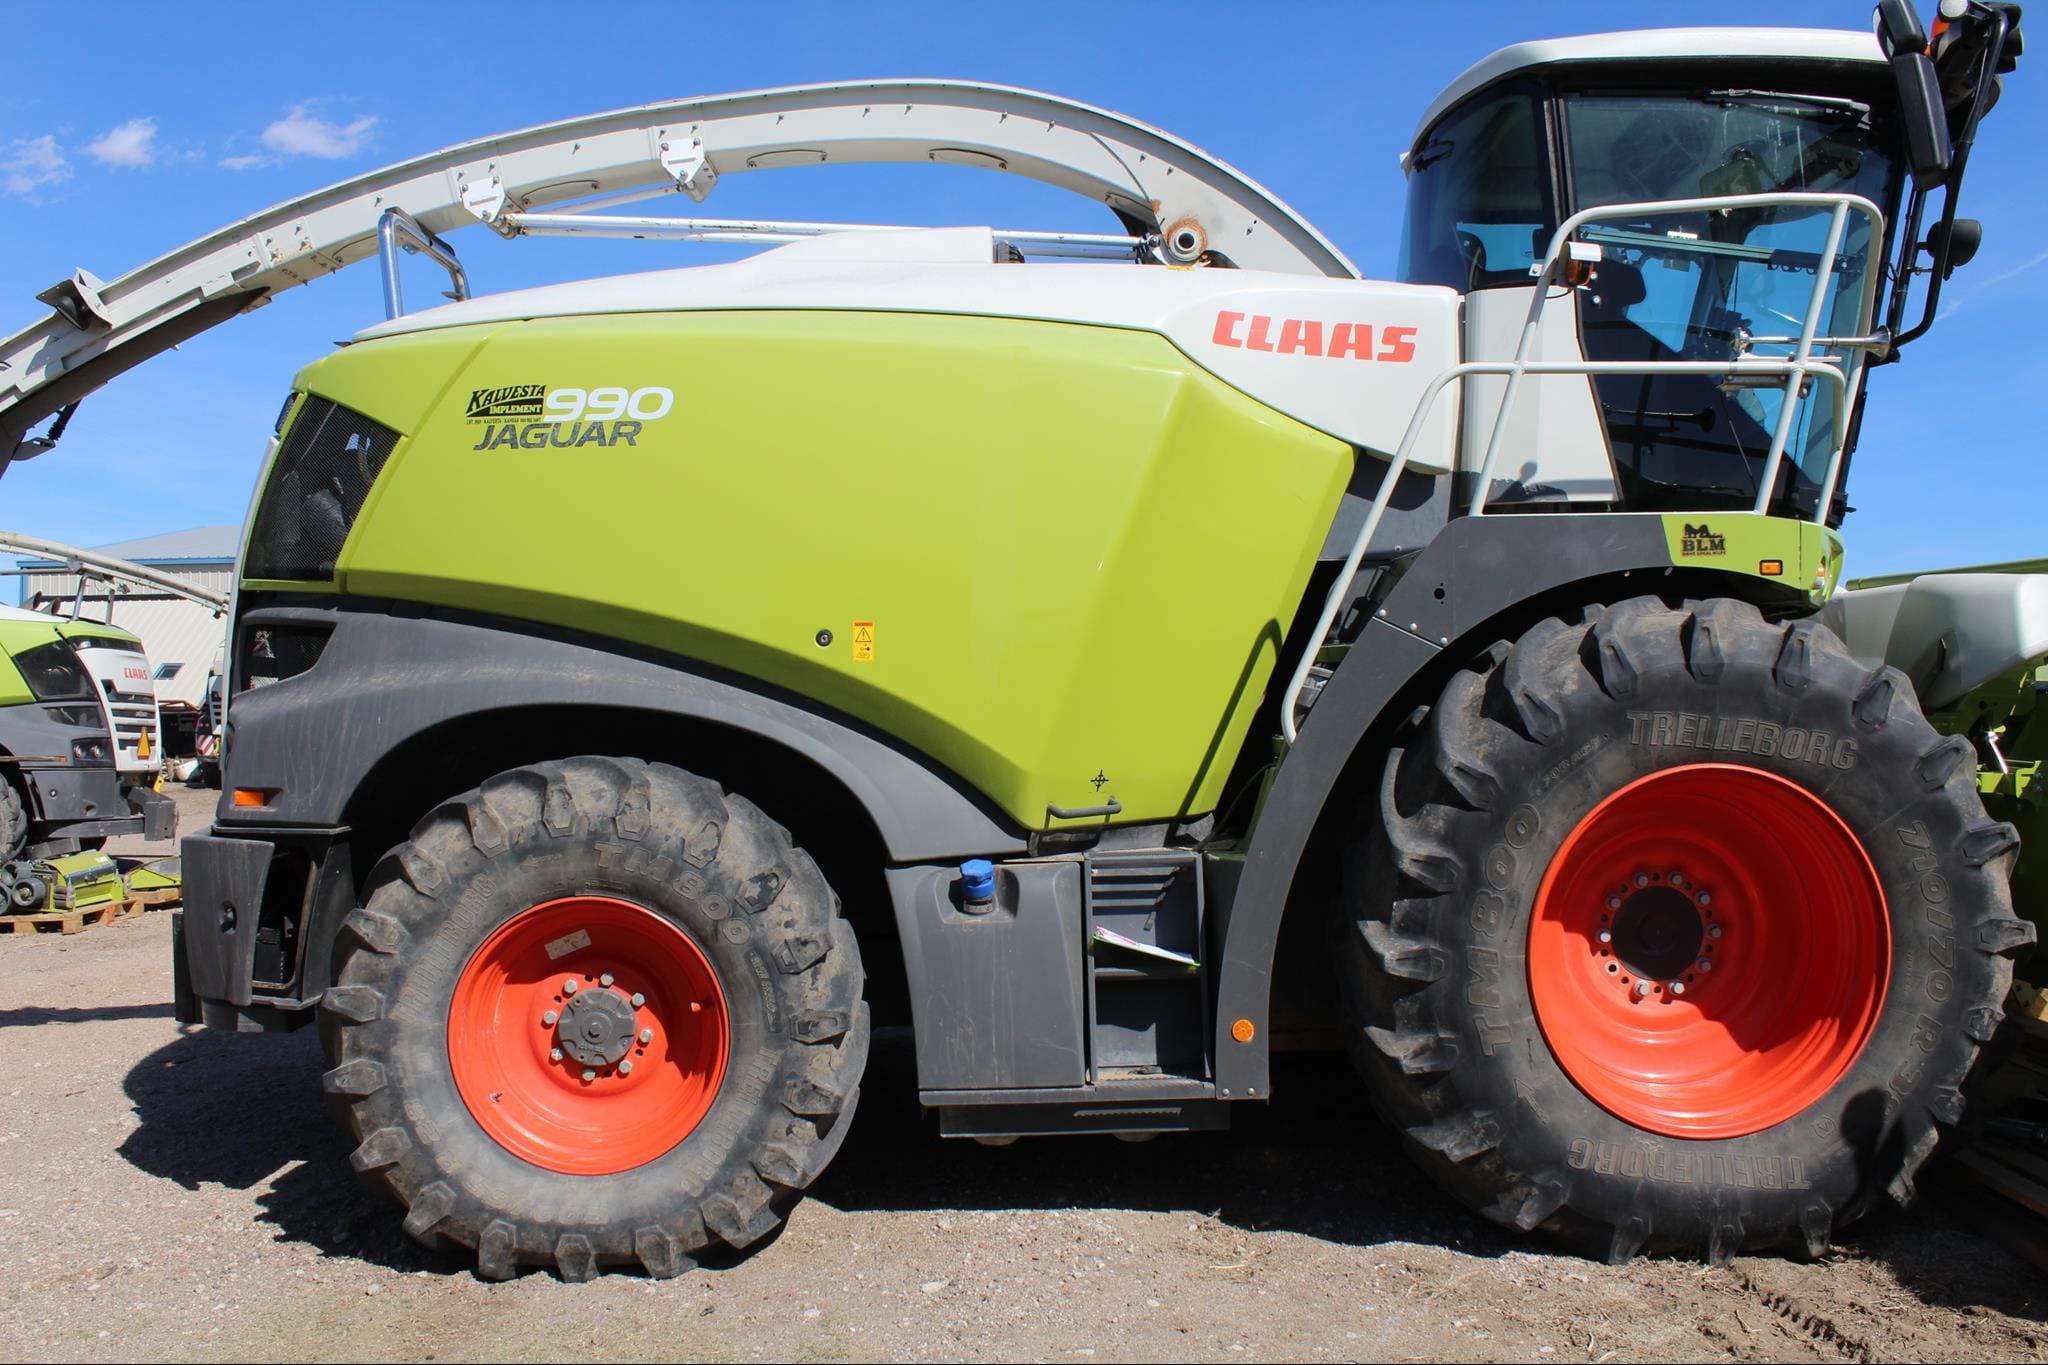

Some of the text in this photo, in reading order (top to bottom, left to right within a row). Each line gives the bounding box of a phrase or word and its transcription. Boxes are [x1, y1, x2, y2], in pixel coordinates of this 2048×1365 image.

[1212, 310, 1418, 363] CLAAS
[465, 385, 547, 414] KALVESTA
[489, 404, 542, 415] IMPLEMENT
[543, 386, 674, 423] 990
[473, 421, 643, 450] JAGUAR
[1681, 538, 1725, 551] BLM
[124, 667, 149, 680] CLAAS
[1626, 710, 1860, 771] TRELLEBORG
[1896, 820, 1955, 1005] 710/70
[1909, 1012, 1943, 1054] R
[1567, 1135, 1811, 1191] TRELLEBORG
